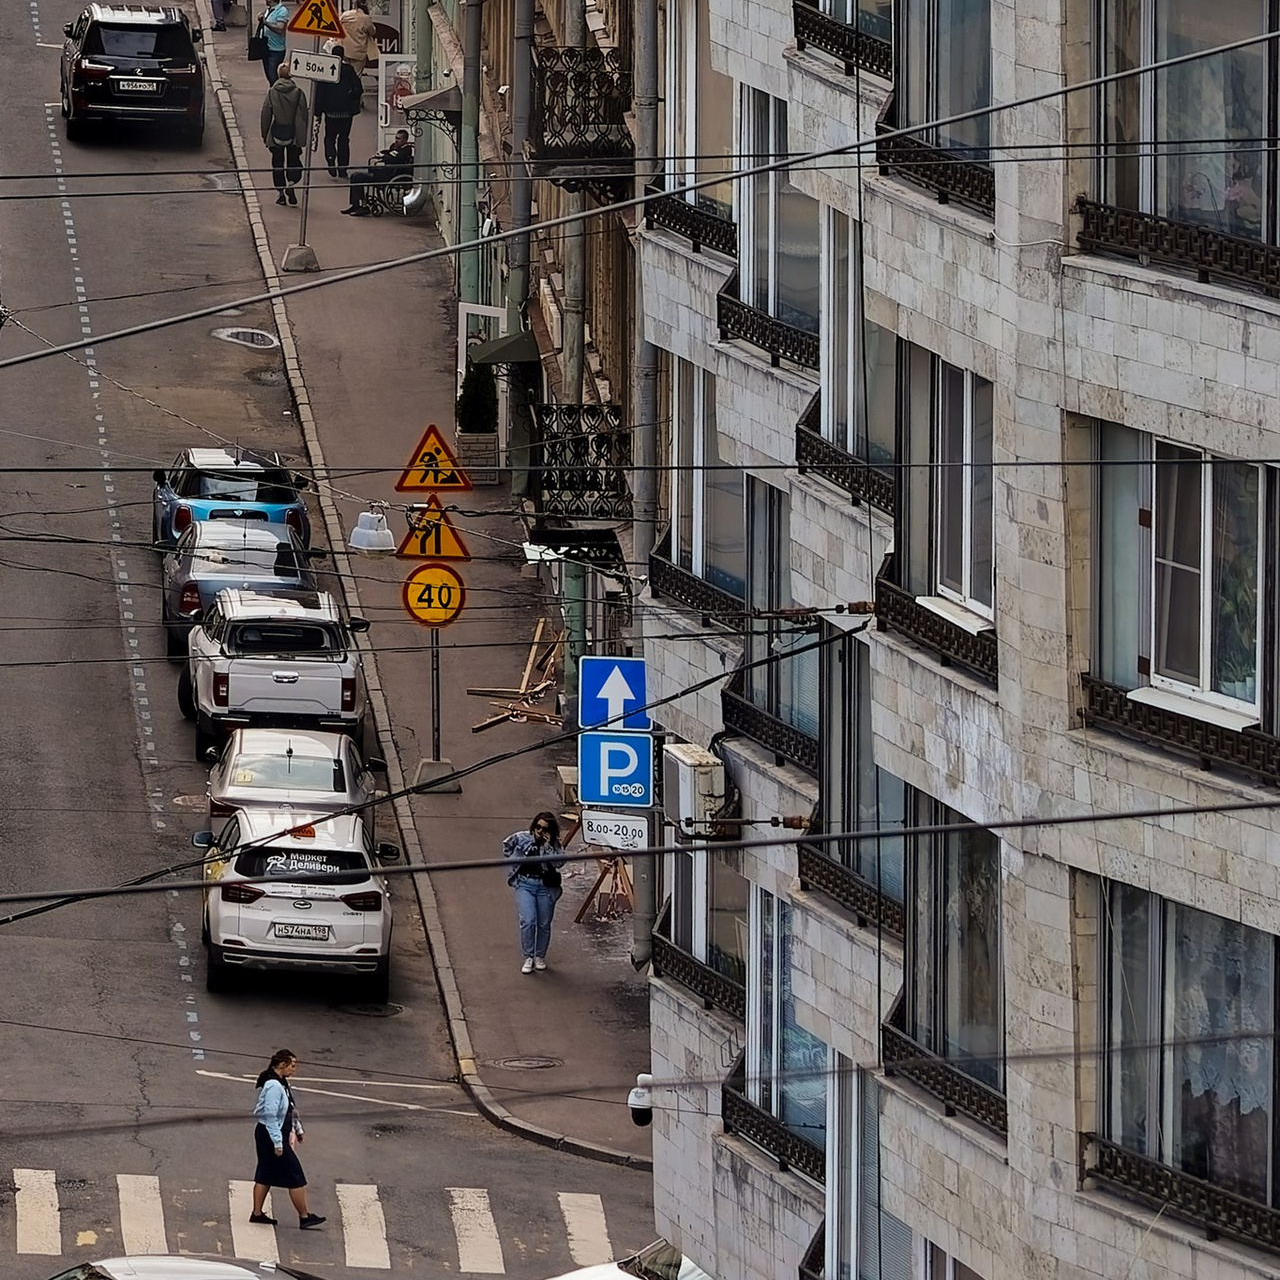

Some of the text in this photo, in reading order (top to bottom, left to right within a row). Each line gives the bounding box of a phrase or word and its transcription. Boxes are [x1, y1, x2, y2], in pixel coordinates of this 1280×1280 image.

[305, 62, 325, 74] 50м
[417, 583, 451, 609] 40
[600, 741, 639, 796] P
[632, 786, 643, 795] 20
[587, 821, 643, 839] 8.00-20.00
[290, 852, 327, 862] Маркет
[290, 859, 340, 873] Деливери
